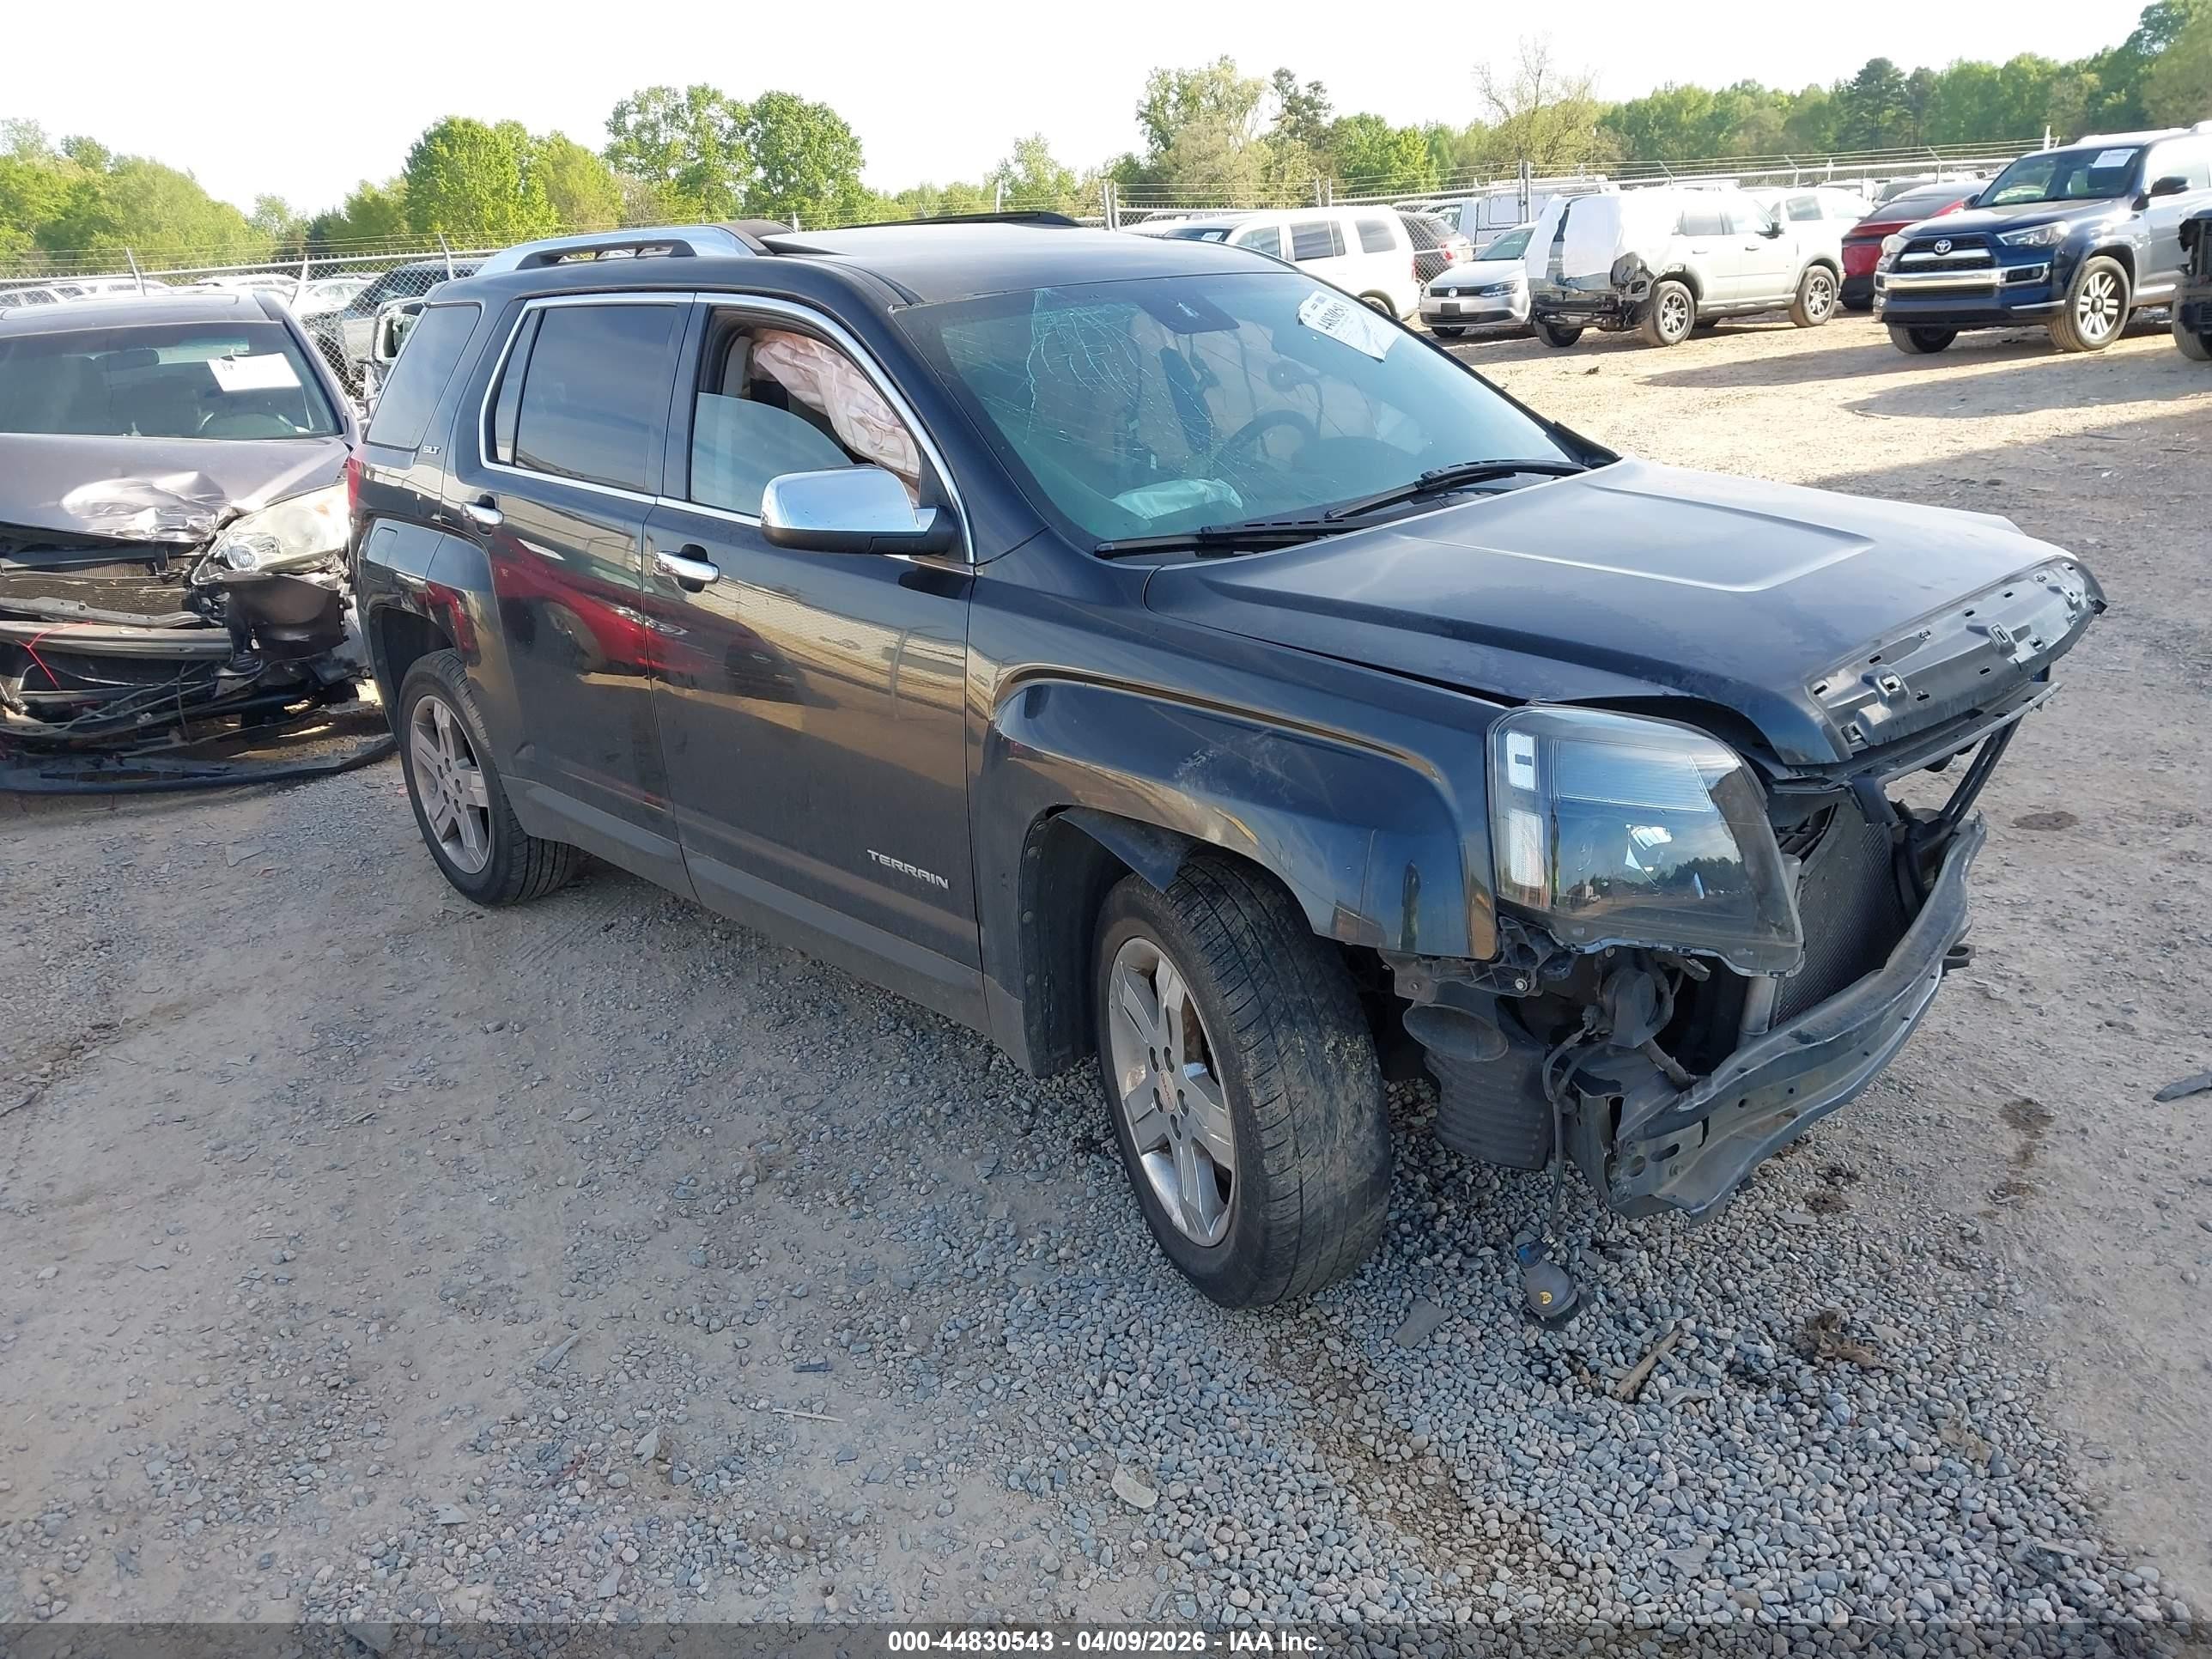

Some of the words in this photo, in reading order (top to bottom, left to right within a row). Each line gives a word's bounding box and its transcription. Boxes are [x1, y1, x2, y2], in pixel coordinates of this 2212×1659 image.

[422, 445, 441, 454] SLT
[866, 848, 950, 890] TERRAIN
[1160, 1072, 1174, 1108] GMC
